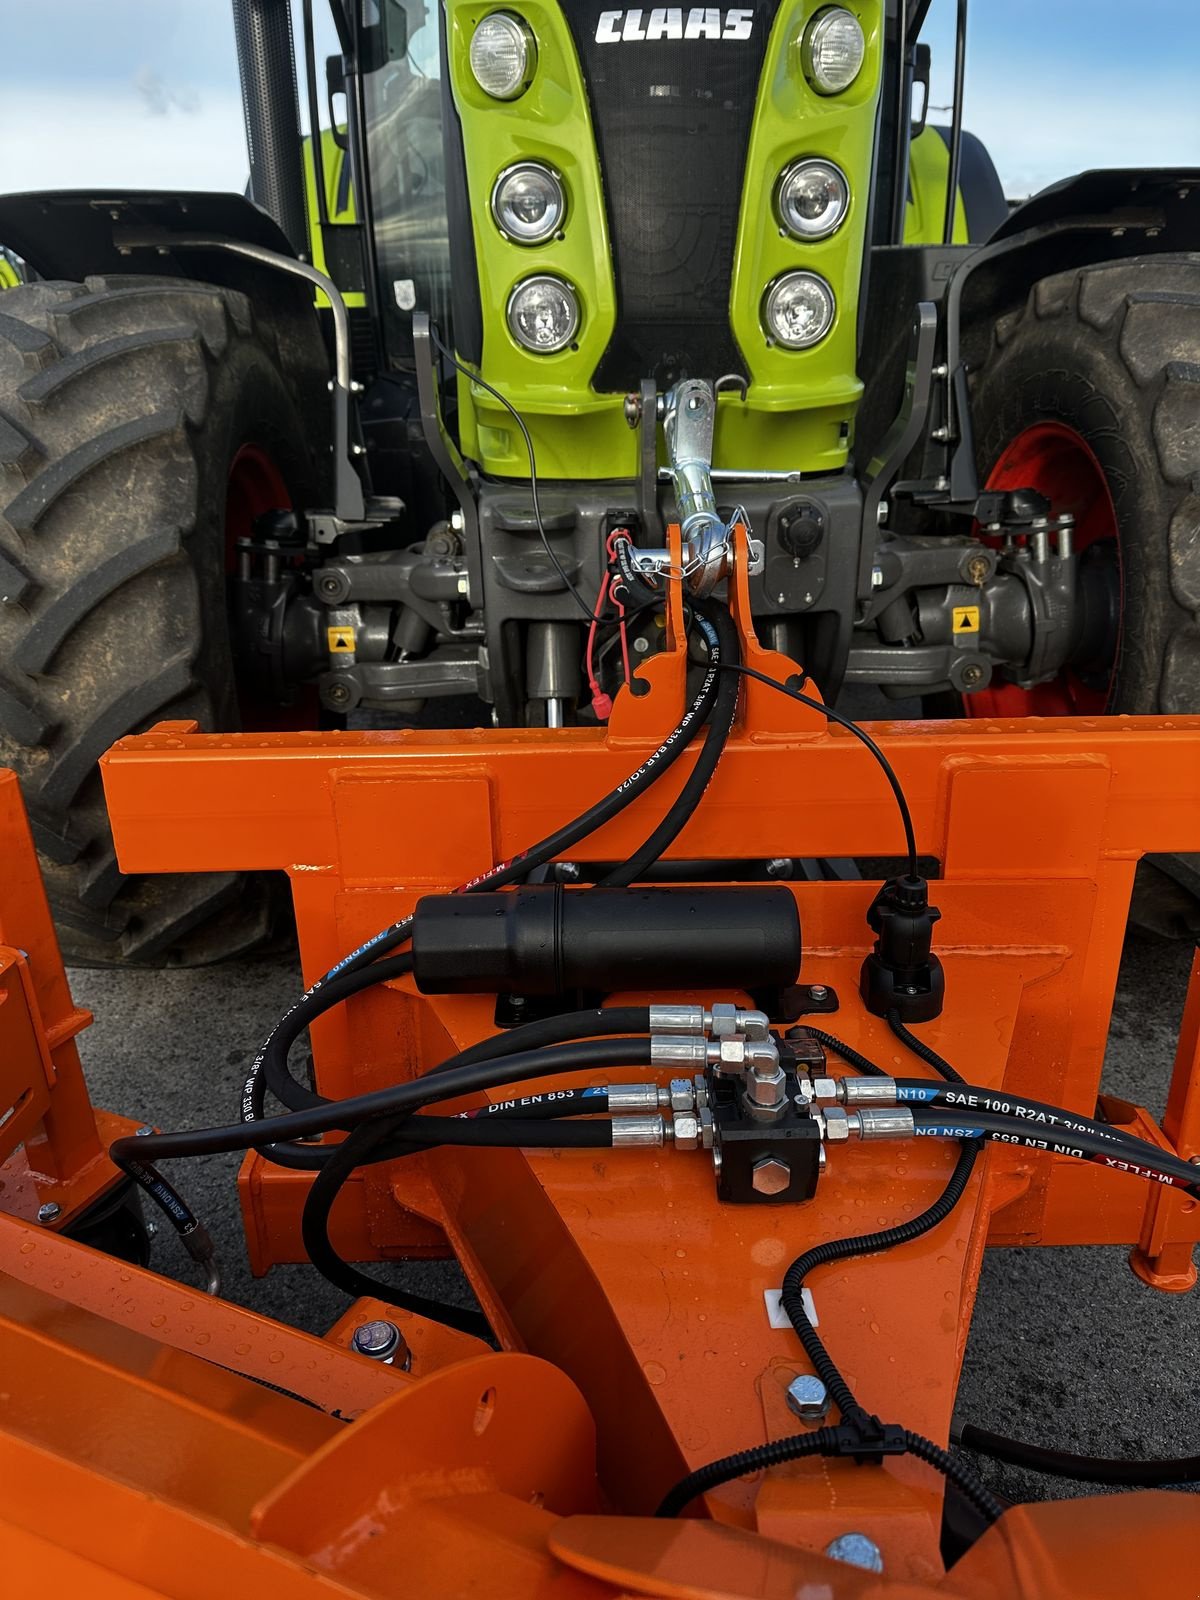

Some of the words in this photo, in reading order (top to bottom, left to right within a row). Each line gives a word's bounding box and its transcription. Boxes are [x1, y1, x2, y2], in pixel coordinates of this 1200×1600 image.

[595, 8, 754, 43] CLAAS
[711, 647, 719, 660] SAE
[701, 673, 715, 693] R2AT
[681, 712, 695, 727] WP
[666, 728, 682, 744] 330
[645, 745, 667, 766] BAR
[332, 949, 361, 972] DN10
[300, 981, 322, 1002] SAE
[250, 1055, 264, 1075] 3/8"
[245, 1077, 256, 1094] WP
[242, 1096, 252, 1113] 330
[488, 1099, 515, 1113] DIN
[520, 1095, 542, 1106] EN
[547, 1089, 575, 1101] 853
[898, 1089, 926, 1100] N10
[945, 1092, 978, 1107] SAE
[983, 1099, 1010, 1113] 100
[1015, 1106, 1058, 1125] R2AT
[915, 1128, 937, 1137] DN
[943, 1128, 974, 1138] 2SN
[992, 1132, 1020, 1144] 853
[1025, 1139, 1048, 1150] EN
[1054, 1144, 1084, 1158] DIN
[1105, 1157, 1174, 1185] M-FLEX
[168, 1203, 185, 1218] 2SN
